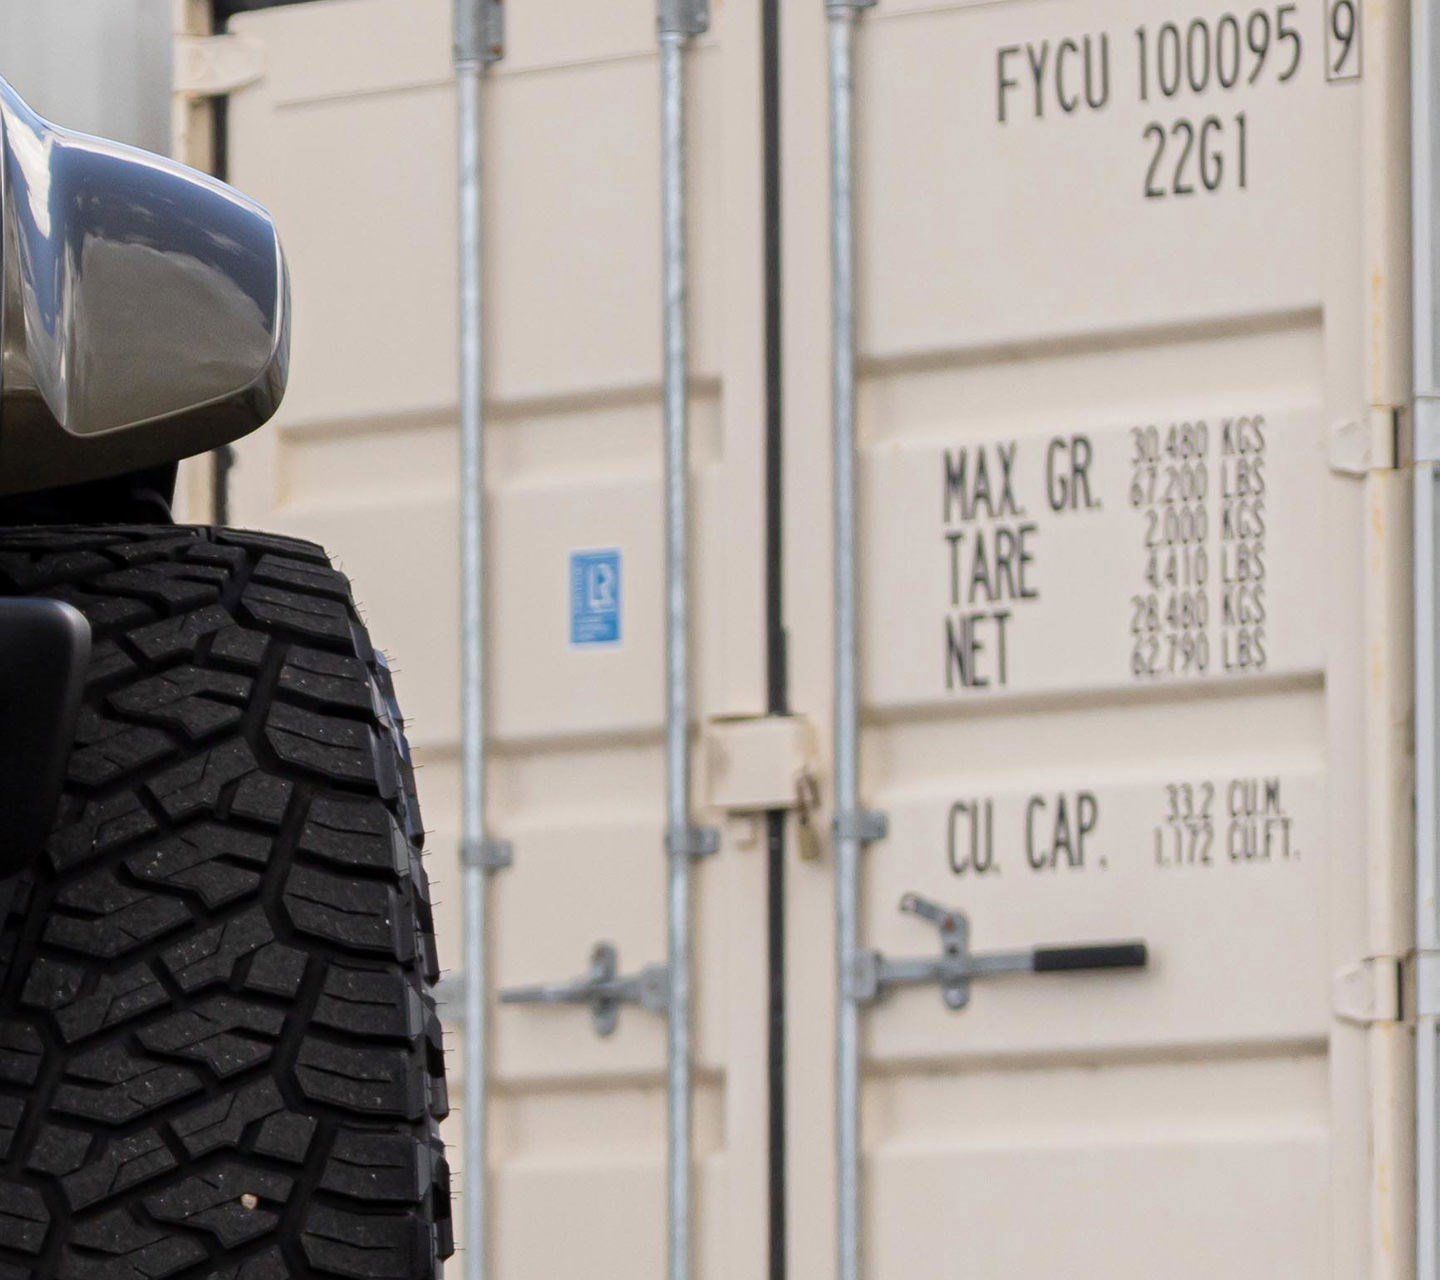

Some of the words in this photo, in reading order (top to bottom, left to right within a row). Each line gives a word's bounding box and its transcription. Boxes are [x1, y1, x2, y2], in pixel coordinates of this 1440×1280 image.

[996, 32, 1109, 123] FYCU
[1136, 3, 1302, 101] 100095
[1143, 112, 1248, 199] 22G1
[1221, 415, 1265, 456] KGS
[1046, 435, 1102, 511] GR.
[1221, 457, 1265, 499] LBS
[1221, 500, 1265, 540] KGS
[945, 523, 1039, 606] TARE
[1221, 542, 1265, 584] LBS
[1221, 584, 1266, 625] KGS
[945, 611, 1011, 689] NET
[1222, 626, 1266, 670] LBS
[1026, 791, 1107, 870] CAP.
